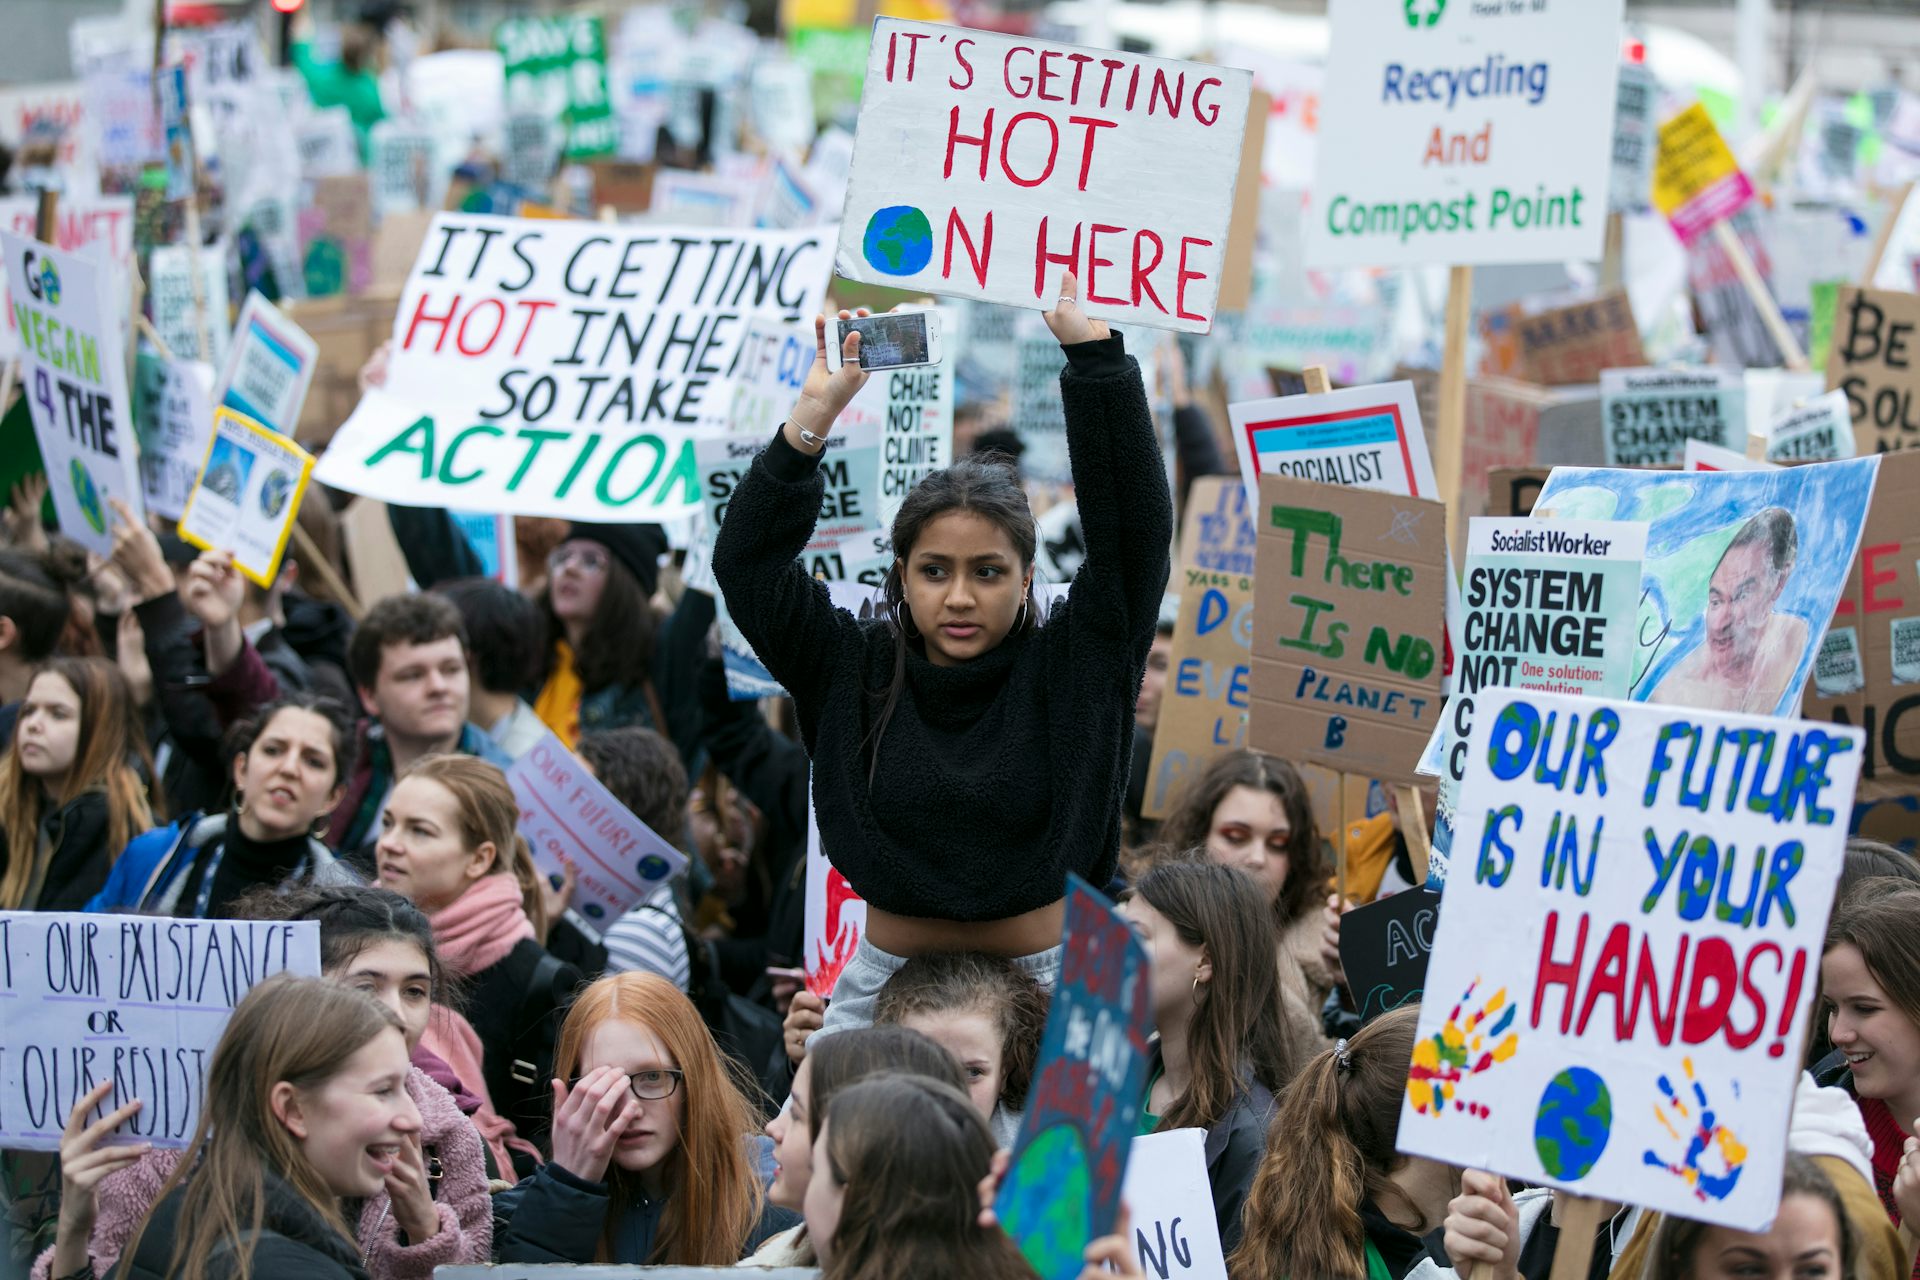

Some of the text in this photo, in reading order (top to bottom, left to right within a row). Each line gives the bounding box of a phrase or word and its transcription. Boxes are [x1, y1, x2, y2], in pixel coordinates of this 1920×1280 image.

[885, 31, 1223, 127] IT'S GETTING
[1382, 57, 1549, 108] Recycling
[943, 104, 1119, 193] HOT
[1422, 122, 1493, 166] And
[1327, 186, 1584, 243] Compost Point
[423, 225, 819, 308] ITS GETTING
[1035, 215, 1213, 323] HERE
[15, 301, 102, 386] VEGAN
[403, 294, 556, 357] HOT
[554, 309, 658, 366] IN
[57, 379, 119, 459] THE
[480, 370, 557, 422] SO
[887, 406, 923, 432] NOT
[1610, 397, 1719, 422] SYSTEM
[1612, 423, 1726, 448] CHANGE
[1270, 503, 1414, 597] There
[1491, 529, 1612, 556] Socialist Worker
[1467, 567, 1604, 613] SYSTEM
[1363, 626, 1435, 680] NO
[1464, 610, 1608, 659] CHANGE
[1296, 665, 1426, 719] PLANET
[1458, 654, 1518, 695] NOT
[1521, 661, 1603, 681] One solution:
[1324, 715, 1348, 749] B
[1487, 700, 1621, 799] OUR
[1644, 720, 1854, 826] FUTURE
[531, 746, 640, 858] OUR FUTURE
[1475, 803, 1805, 928] IS IN YOUR
[47, 921, 99, 997] OUR
[1530, 909, 1808, 1059] HANDS!
[88, 1010, 124, 1034] OR
[23, 1045, 103, 1131] OUR
